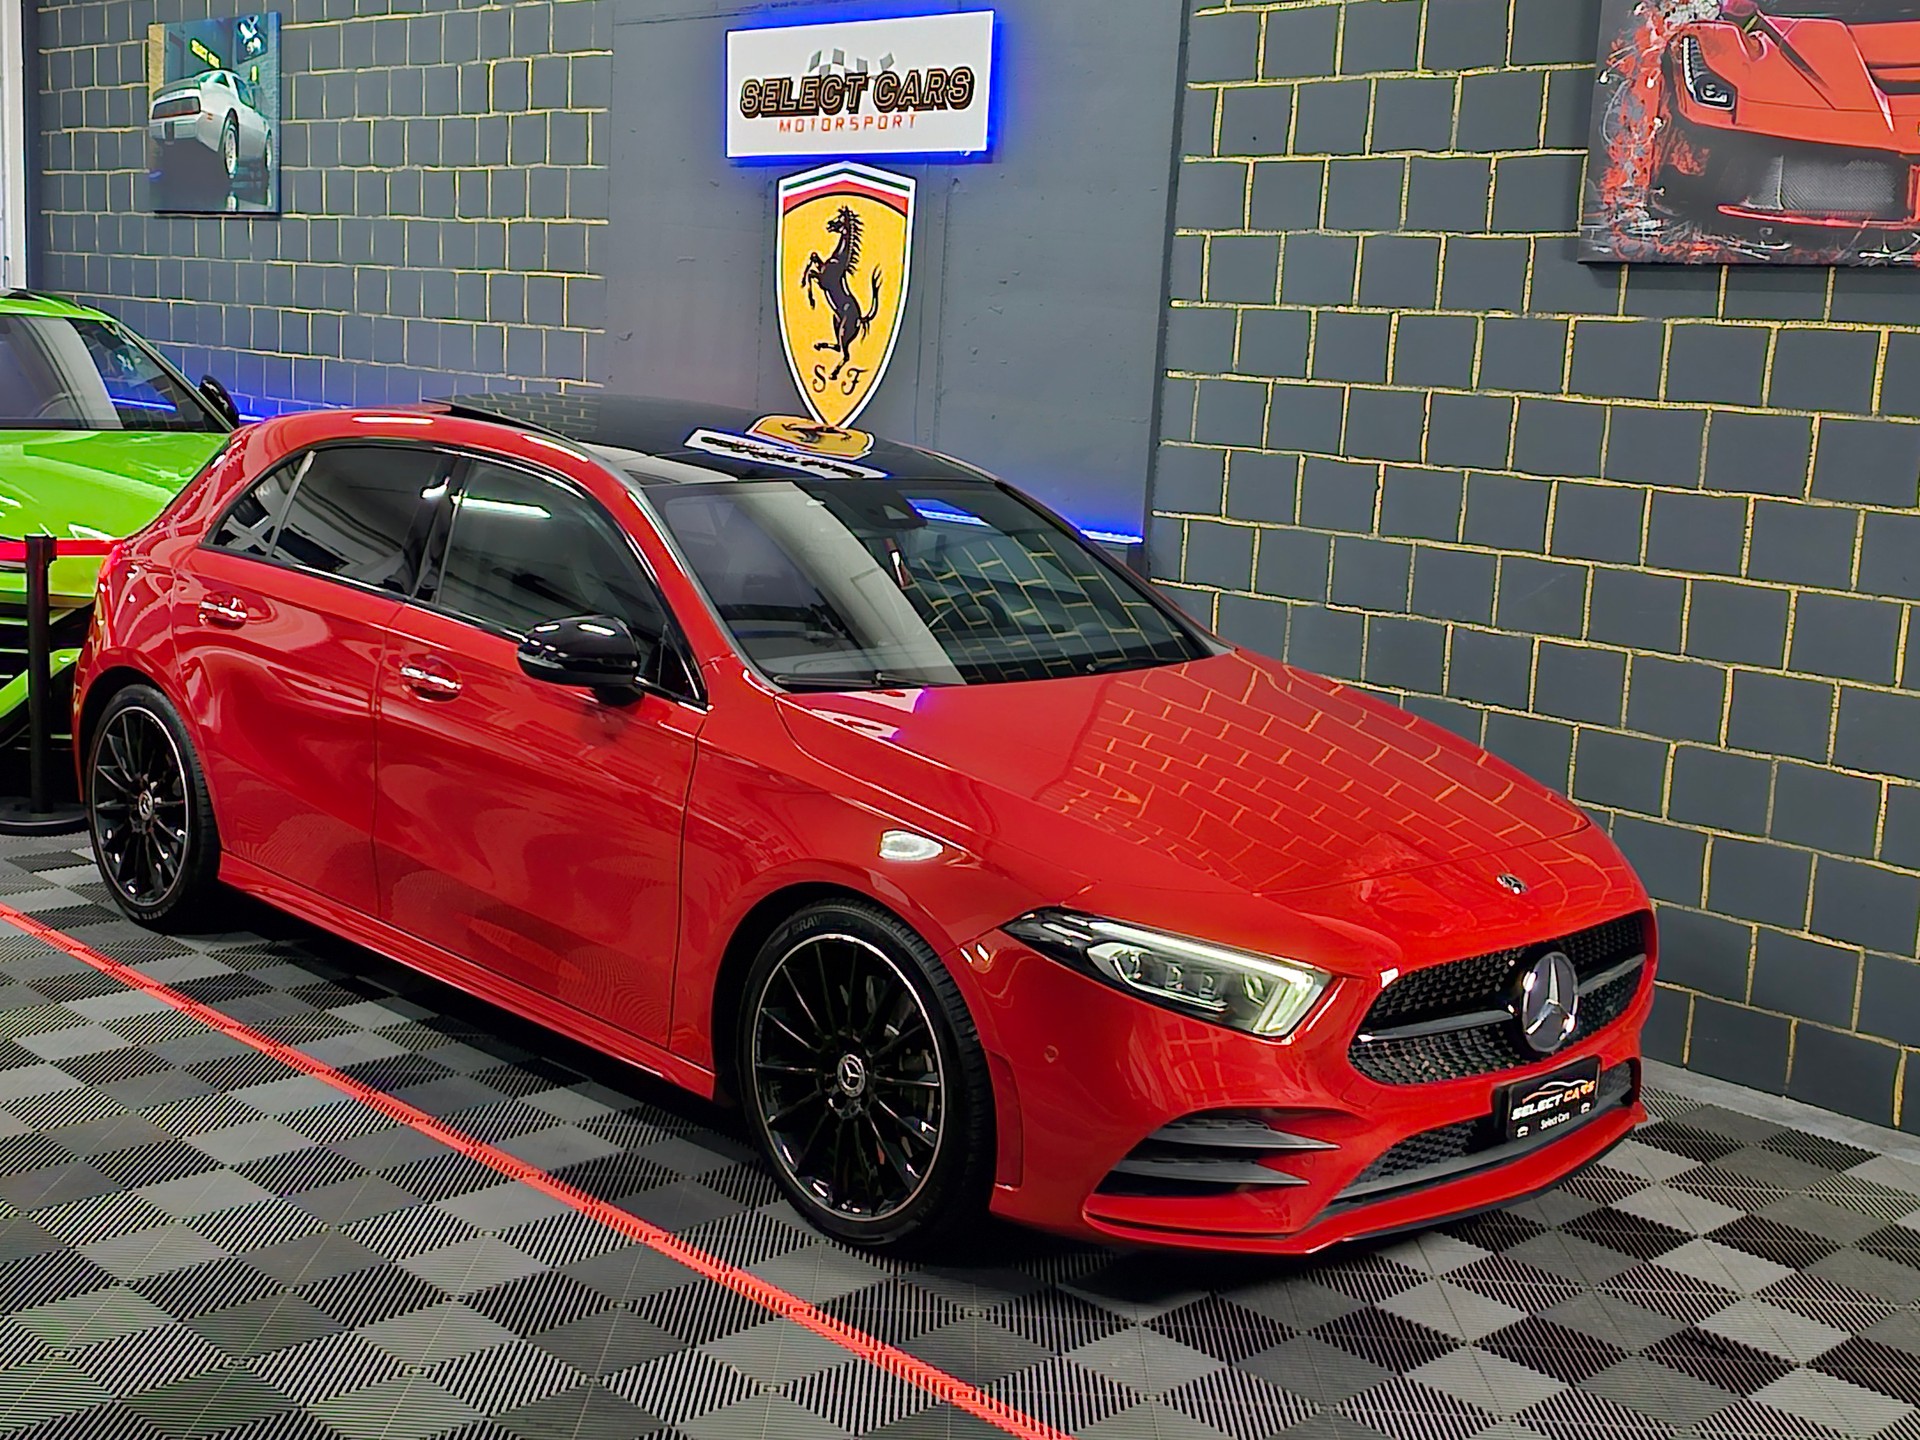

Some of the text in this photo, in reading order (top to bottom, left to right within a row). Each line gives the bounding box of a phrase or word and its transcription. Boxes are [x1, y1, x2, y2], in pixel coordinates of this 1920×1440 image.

[740, 66, 975, 118] SELECT CARS
[779, 114, 917, 133] MOTORSPORT
[812, 364, 869, 396] S F
[1511, 1093, 1563, 1120] SELECT
